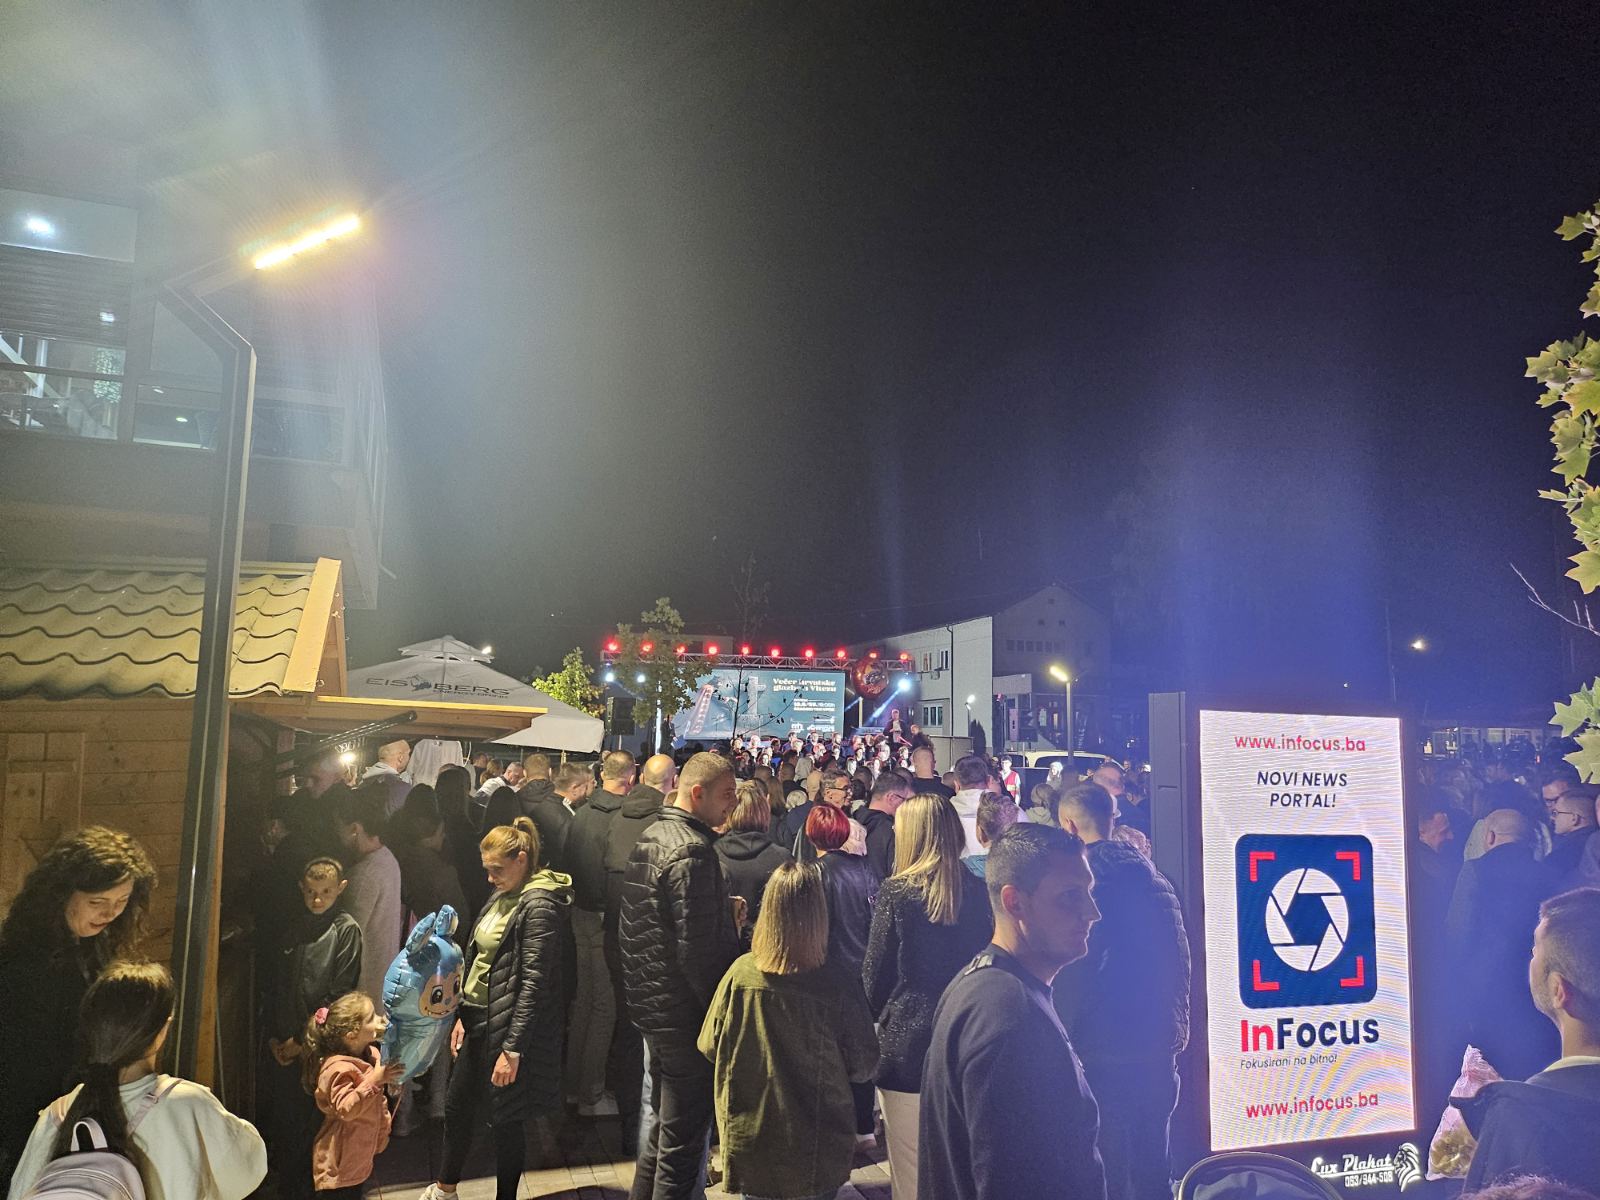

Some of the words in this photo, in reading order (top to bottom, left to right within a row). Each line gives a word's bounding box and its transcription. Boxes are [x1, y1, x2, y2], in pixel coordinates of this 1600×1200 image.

[1234, 734, 1366, 751] www.infocus.ba
[1257, 771, 1298, 786] NOVI
[1302, 772, 1348, 787] NEWS
[1269, 793, 1336, 808] PORTAL!
[1240, 1017, 1380, 1053] InFocus
[1240, 1056, 1291, 1069] Fokusirani
[1293, 1056, 1307, 1066] na
[1309, 1054, 1338, 1065] bitno!
[1245, 1092, 1379, 1119] www.infocus.ba
[1310, 1157, 1338, 1175] Lux
[1342, 1153, 1393, 1172] Plakat
